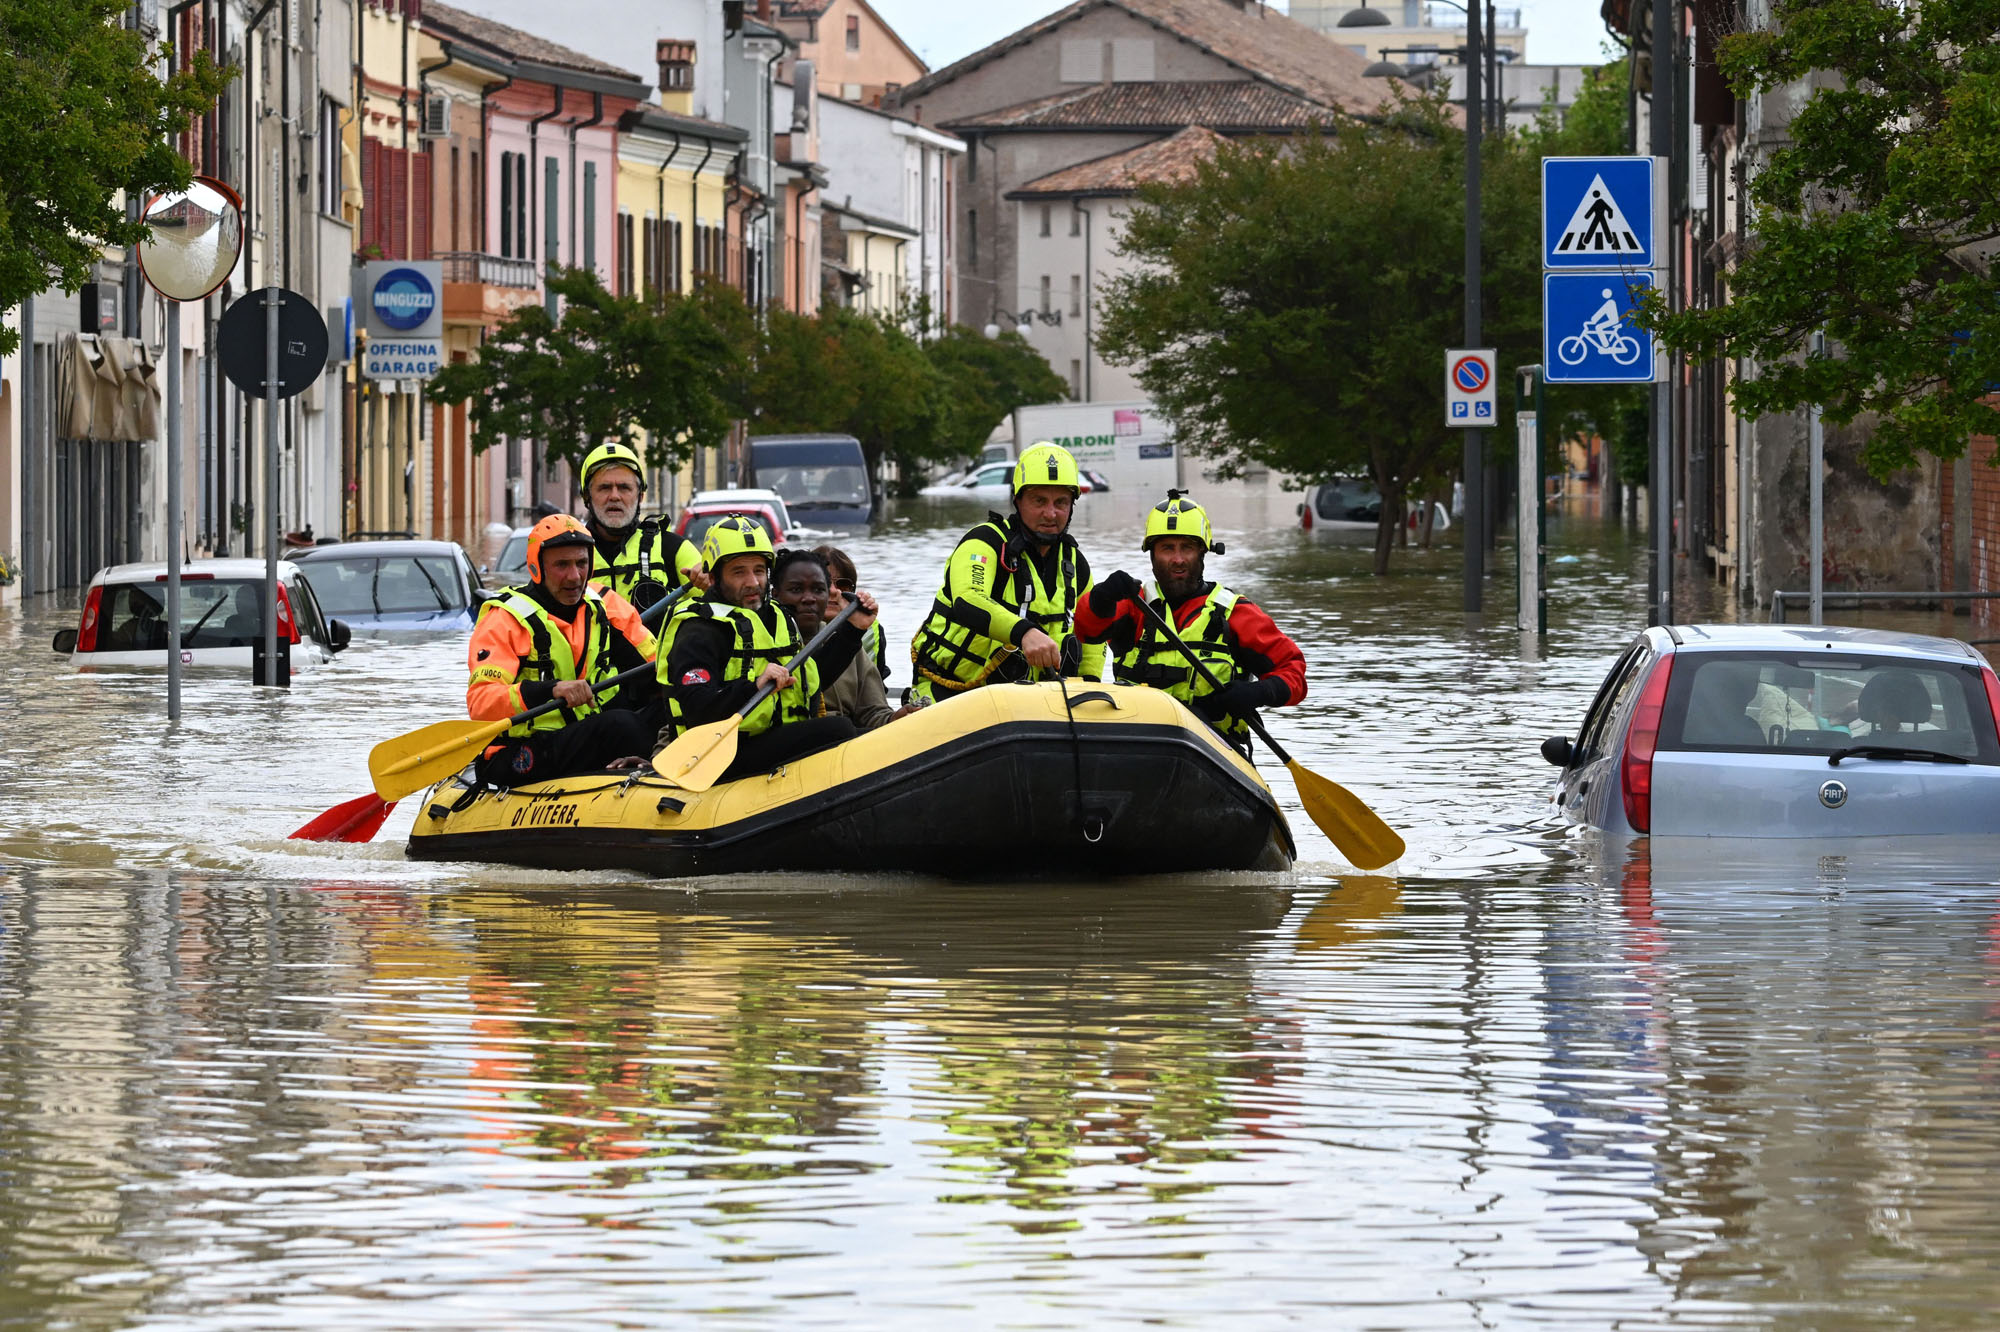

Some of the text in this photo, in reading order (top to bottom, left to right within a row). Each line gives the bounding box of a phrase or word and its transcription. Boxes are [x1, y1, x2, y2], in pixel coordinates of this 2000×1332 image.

[375, 293, 432, 307] MINGUZZI
[370, 344, 437, 356] OFFICINA
[370, 362, 437, 374] GARAGE
[1455, 404, 1465, 416] P
[1053, 435, 1116, 447] TARONI
[1825, 789, 1842, 798] FIAT
[530, 804, 579, 827] VITERB
